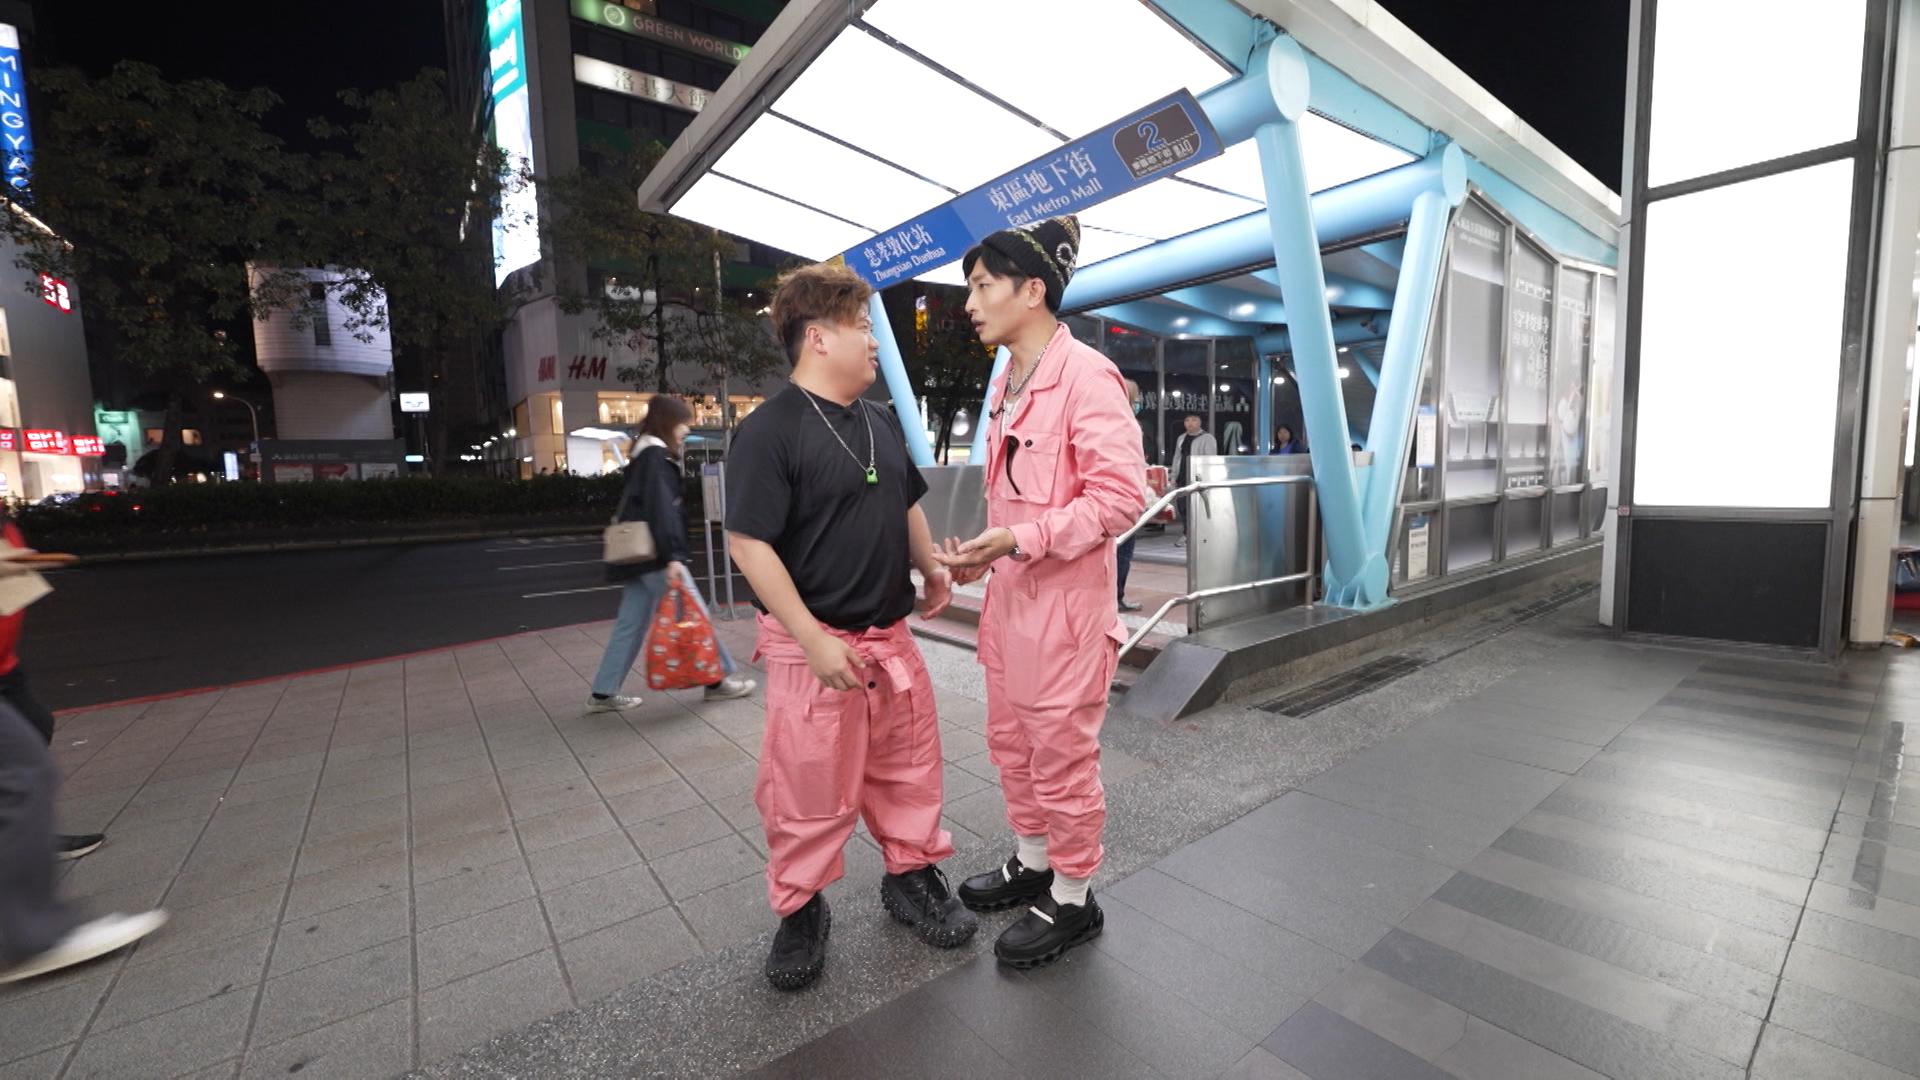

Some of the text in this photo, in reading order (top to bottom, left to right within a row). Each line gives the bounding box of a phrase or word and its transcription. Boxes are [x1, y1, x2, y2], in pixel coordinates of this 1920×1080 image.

[633, 16, 742, 60] GREEN WORLD
[1138, 121, 1167, 154] 2
[987, 147, 1097, 213] 東區地下街
[1006, 177, 1103, 226] East Metro Mall
[864, 224, 934, 268] 忠孝敦化站
